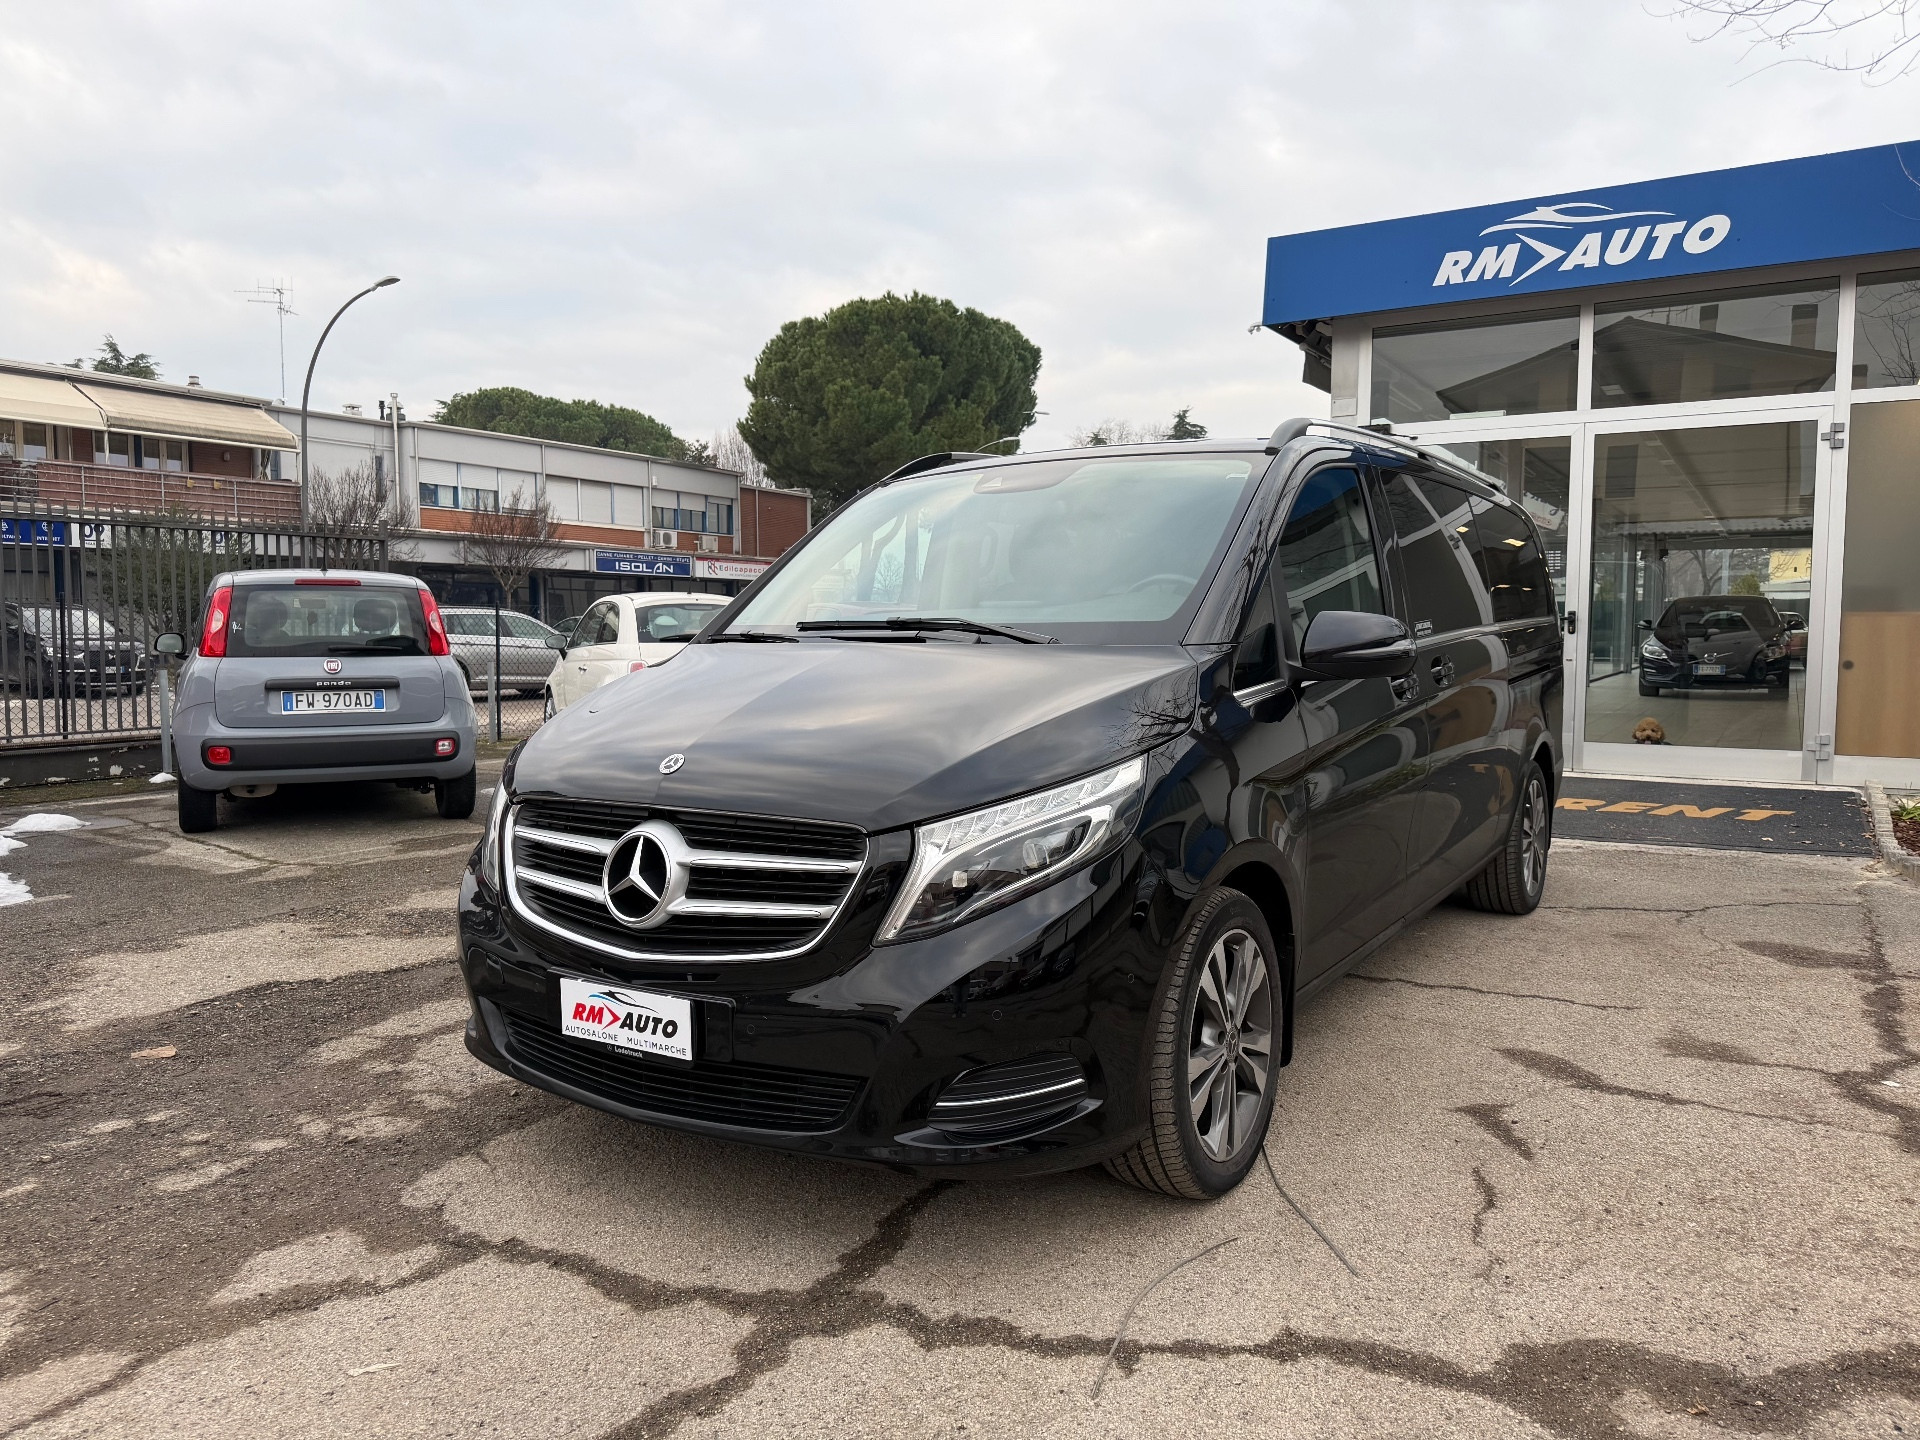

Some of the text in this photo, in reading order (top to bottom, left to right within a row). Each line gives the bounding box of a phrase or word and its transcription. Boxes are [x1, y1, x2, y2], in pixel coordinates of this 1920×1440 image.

[1432, 214, 1732, 287] RM AUTO
[615, 561, 674, 575] ISOLAN
[327, 662, 339, 670] FIAT
[1554, 797, 1796, 821] RENT
[572, 1002, 679, 1039] RM AUTO
[564, 1024, 687, 1057] AUTOSALONE MULTIMARCHE
